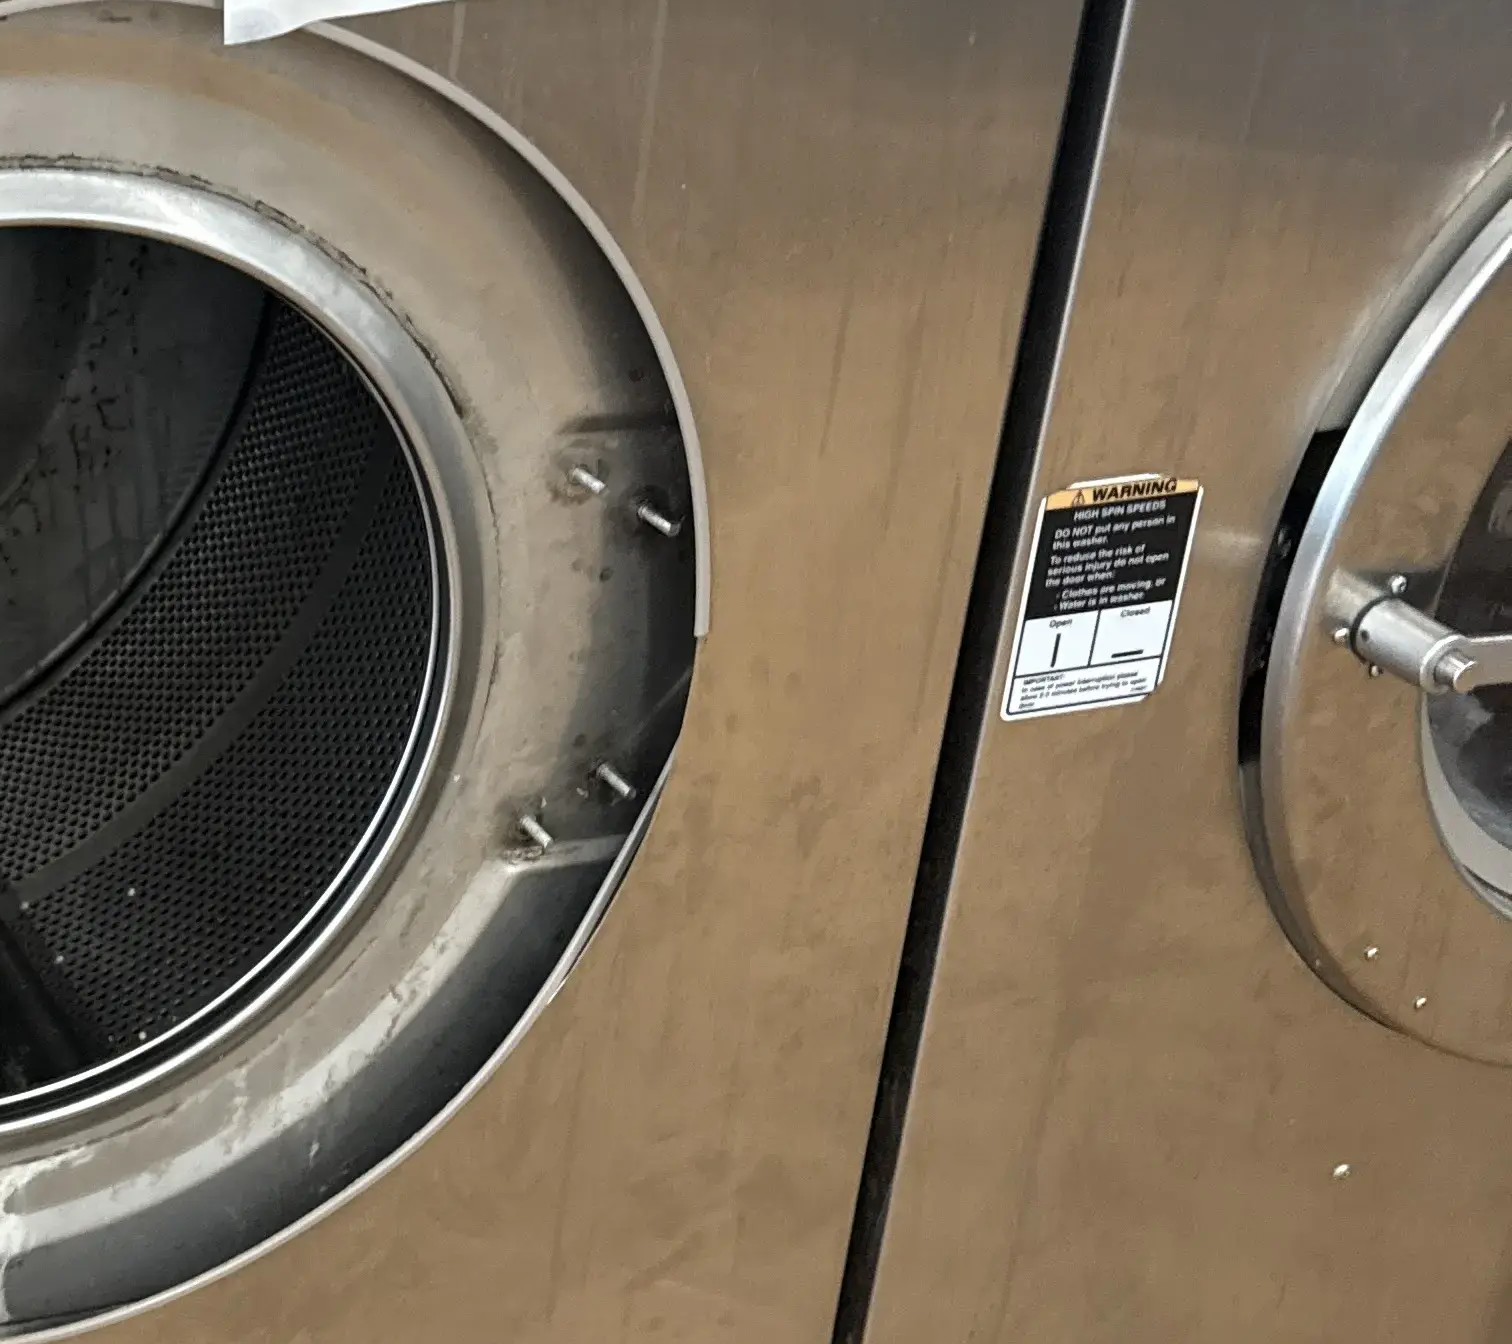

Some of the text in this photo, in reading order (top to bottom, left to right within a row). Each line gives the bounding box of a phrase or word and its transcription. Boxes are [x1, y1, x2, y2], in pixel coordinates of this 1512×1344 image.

[1092, 477, 1178, 503] WARNING
[1073, 499, 1167, 522] HIGH SPIN SPEEDS
[1054, 515, 1176, 539] DO NOT put any person in
[1050, 543, 1146, 566] To reduce the risk of
[1052, 540, 1070, 551] this
[1048, 552, 1169, 576] serious injury do not open
[1045, 577, 1061, 588] the
[1062, 574, 1085, 586] door
[1062, 588, 1098, 600] Clothes
[1100, 585, 1116, 595] are
[1155, 577, 1166, 587] or
[1059, 599, 1087, 611] Water
[1088, 598, 1097, 607] is
[1098, 596, 1108, 605] in
[1120, 606, 1151, 619] Closed
[1048, 618, 1073, 629] Open
